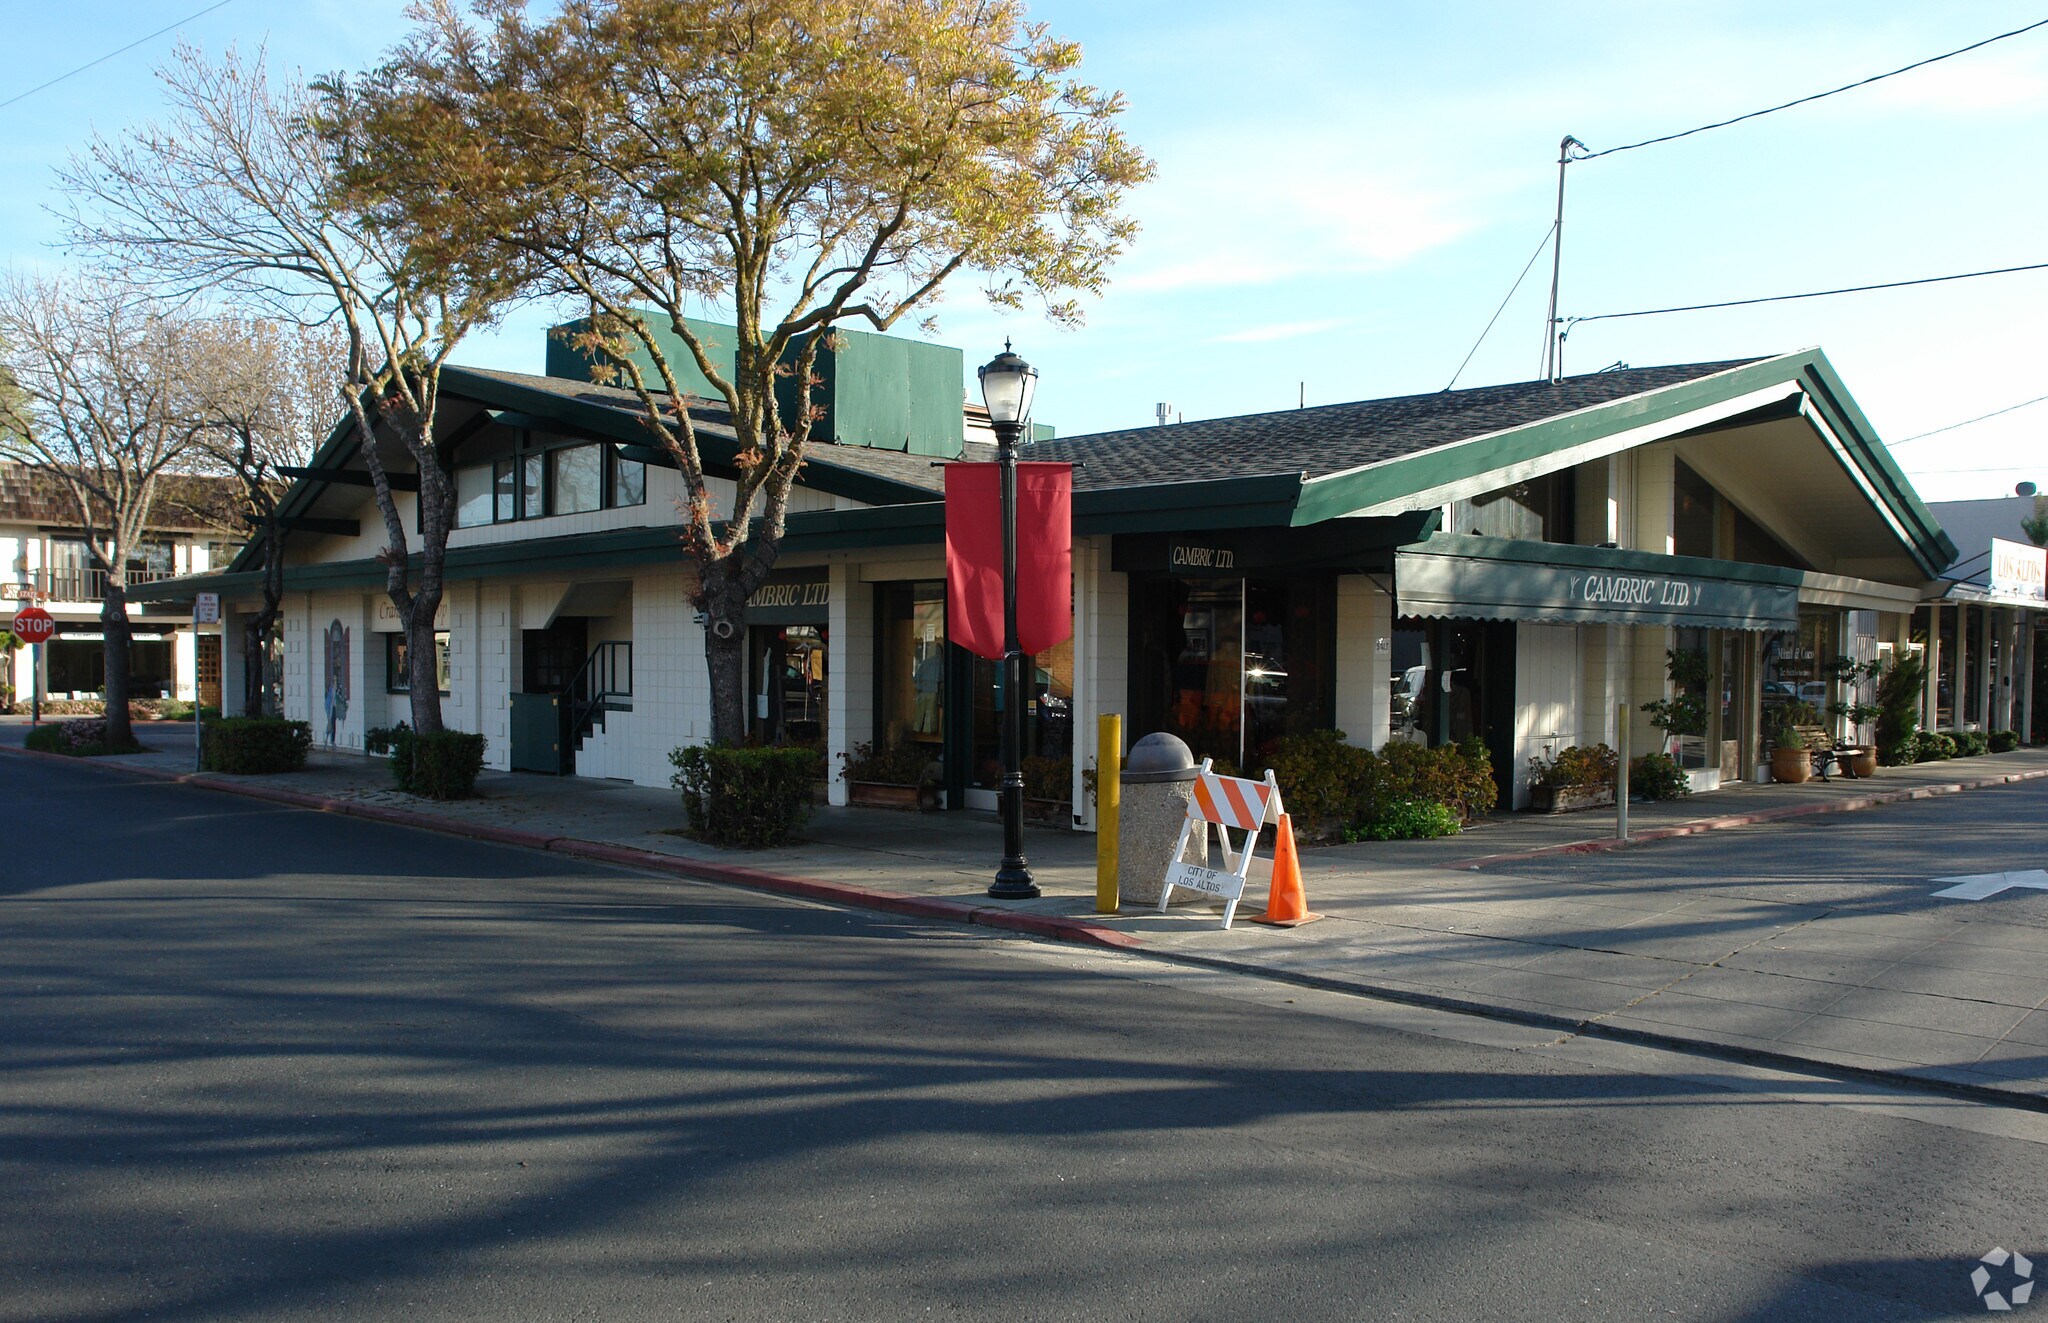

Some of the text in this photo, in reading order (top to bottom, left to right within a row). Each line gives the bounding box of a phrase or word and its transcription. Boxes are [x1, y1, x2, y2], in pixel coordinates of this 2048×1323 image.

[1173, 546, 1234, 568] CAMBRIC LTD.
[1998, 554, 2014, 579] LOS
[746, 584, 800, 607] AMBRIC
[1583, 575, 1689, 606] CAMBRIC LTD.
[15, 617, 53, 633] STOP
[1179, 876, 1221, 892] LOS ALTOS
[1188, 866, 1218, 880] CITY OF
